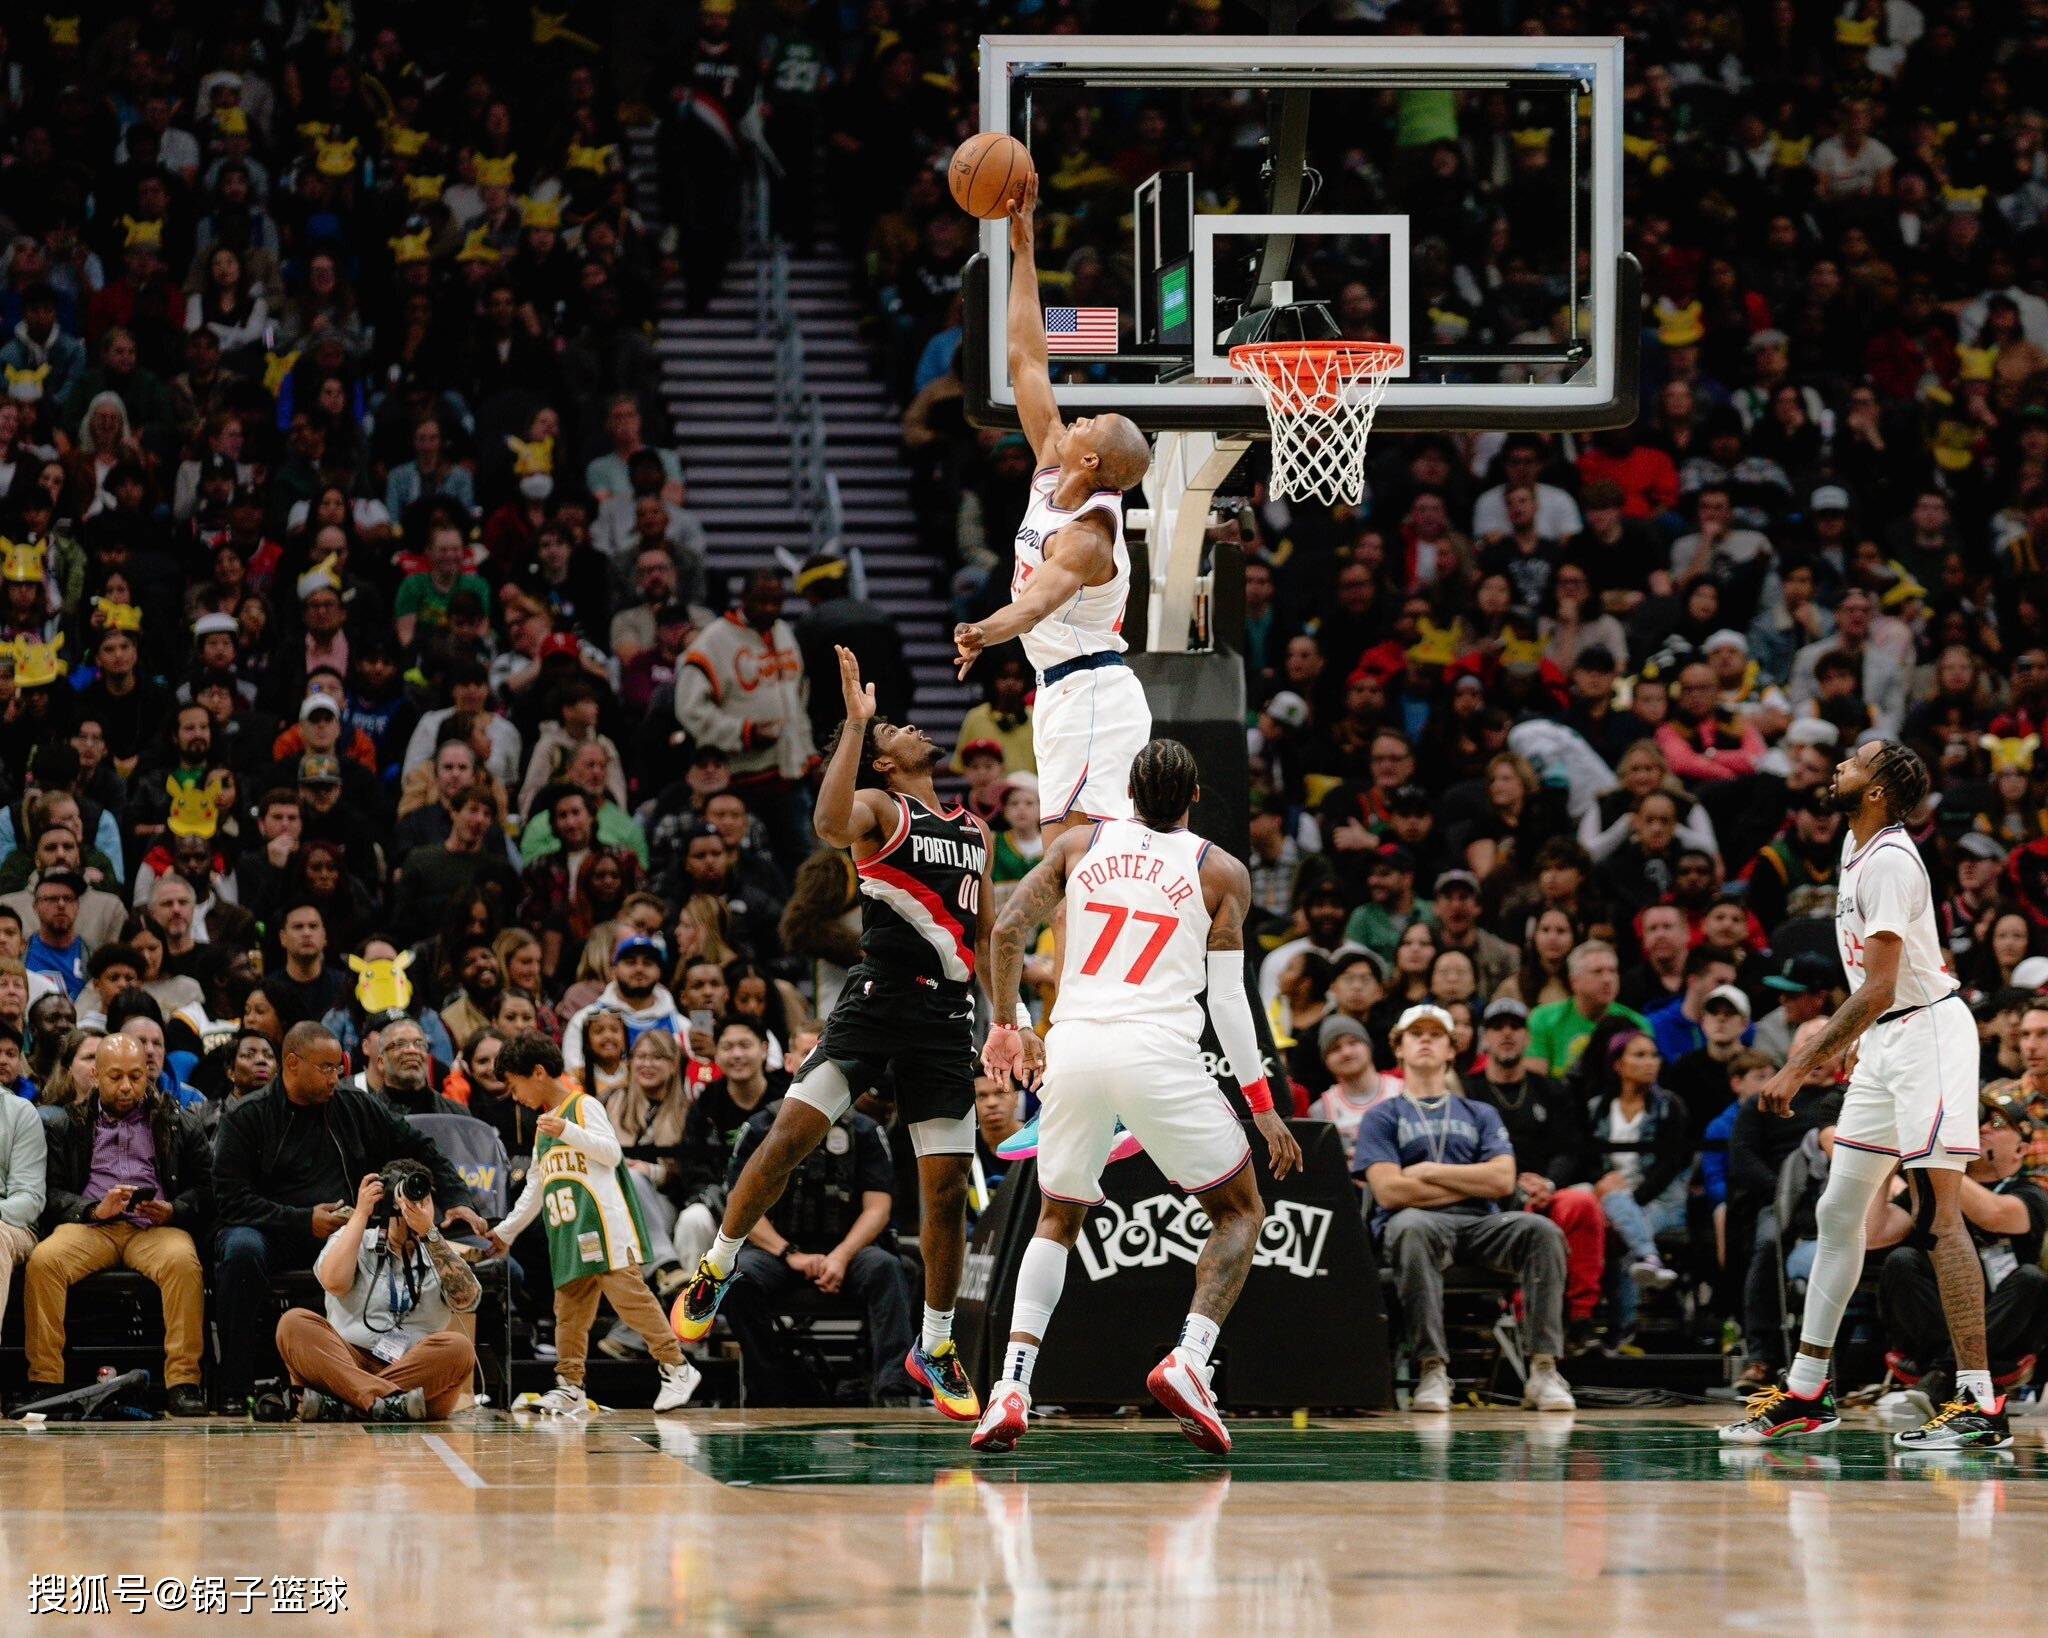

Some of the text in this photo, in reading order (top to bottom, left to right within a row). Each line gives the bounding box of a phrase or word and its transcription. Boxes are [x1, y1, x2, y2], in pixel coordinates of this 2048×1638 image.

[910, 834, 986, 875] PORTLAND
[1077, 854, 1165, 894] PORTER
[957, 873, 980, 915] 00
[1079, 901, 1180, 986] 77
[1199, 1049, 1275, 1077] Bok
[545, 1186, 577, 1227] 35
